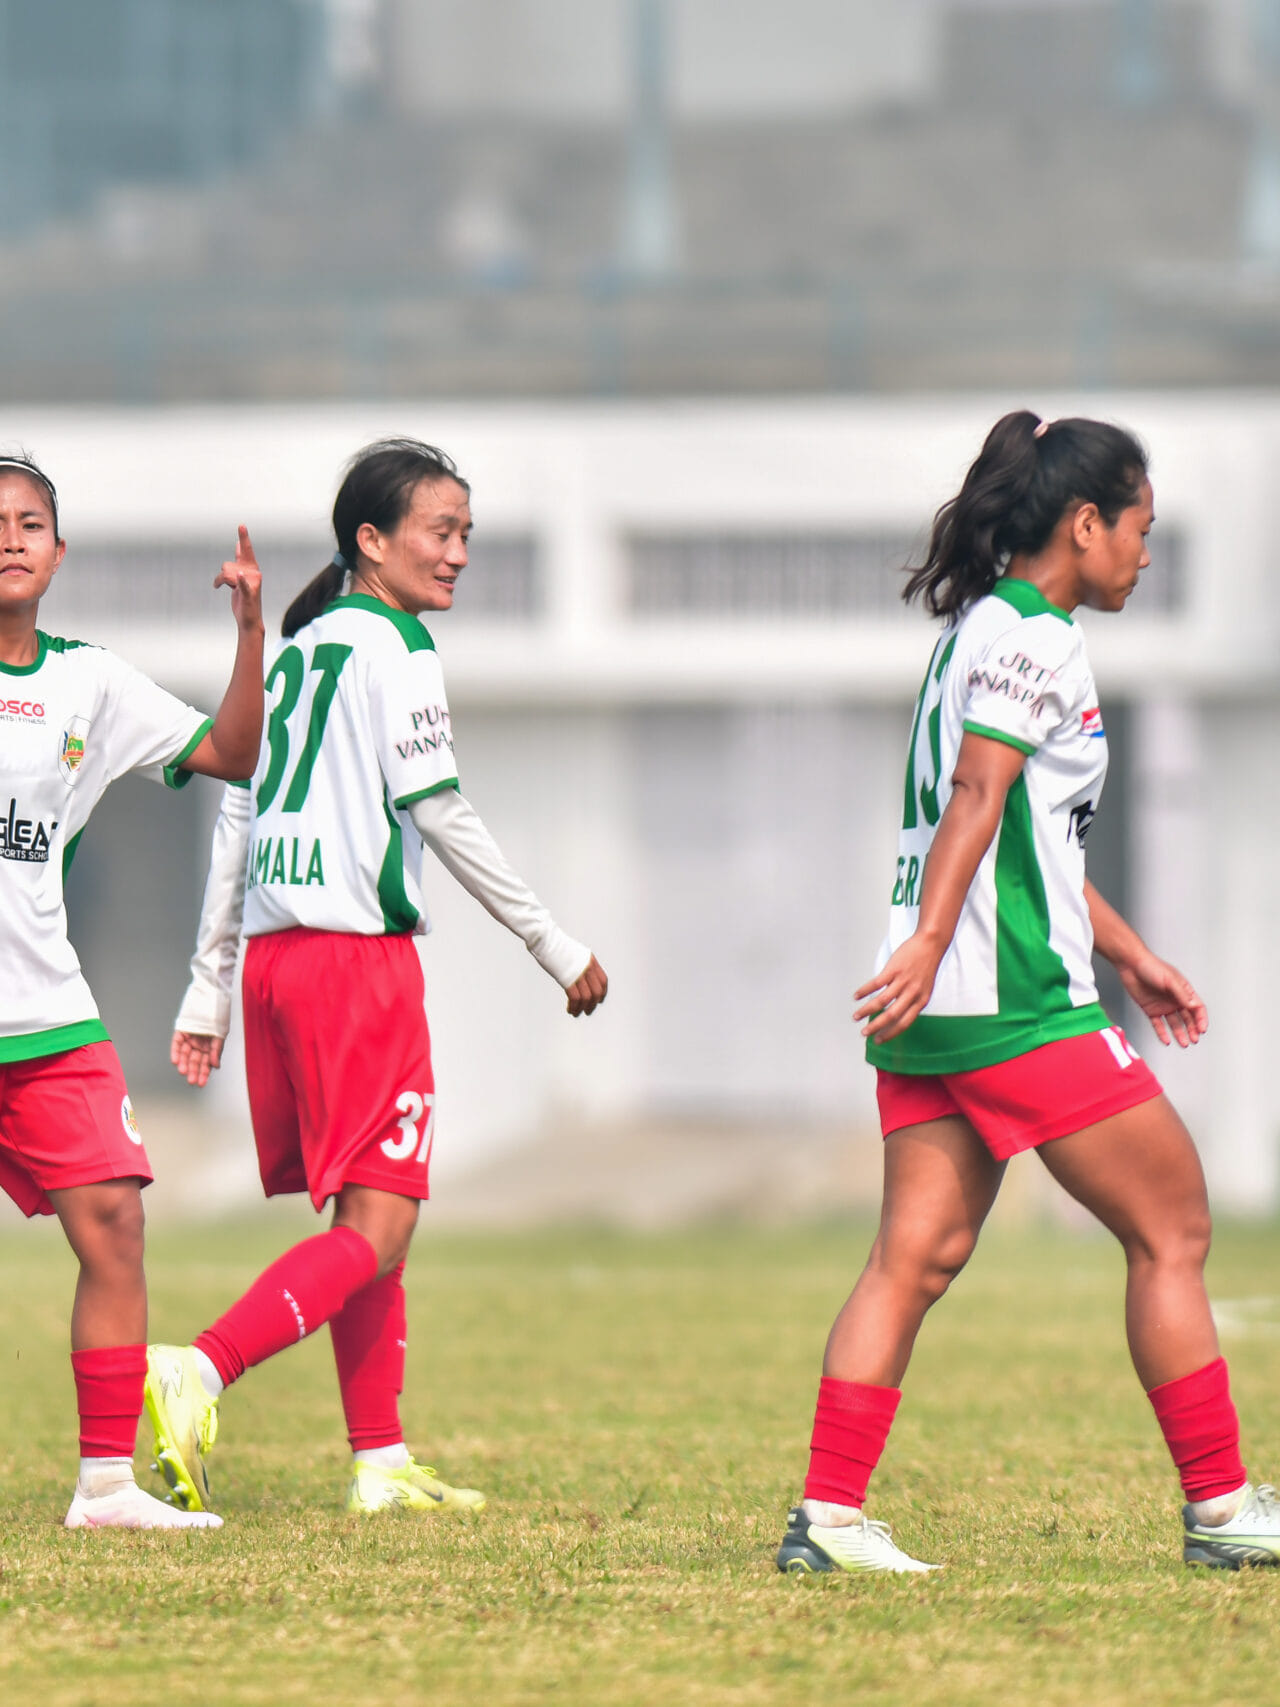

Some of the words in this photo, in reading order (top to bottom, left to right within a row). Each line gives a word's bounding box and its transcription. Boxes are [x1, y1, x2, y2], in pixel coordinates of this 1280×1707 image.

[256, 643, 353, 818] 37
[395, 730, 456, 760] VANA
[380, 1090, 436, 1164] 37
